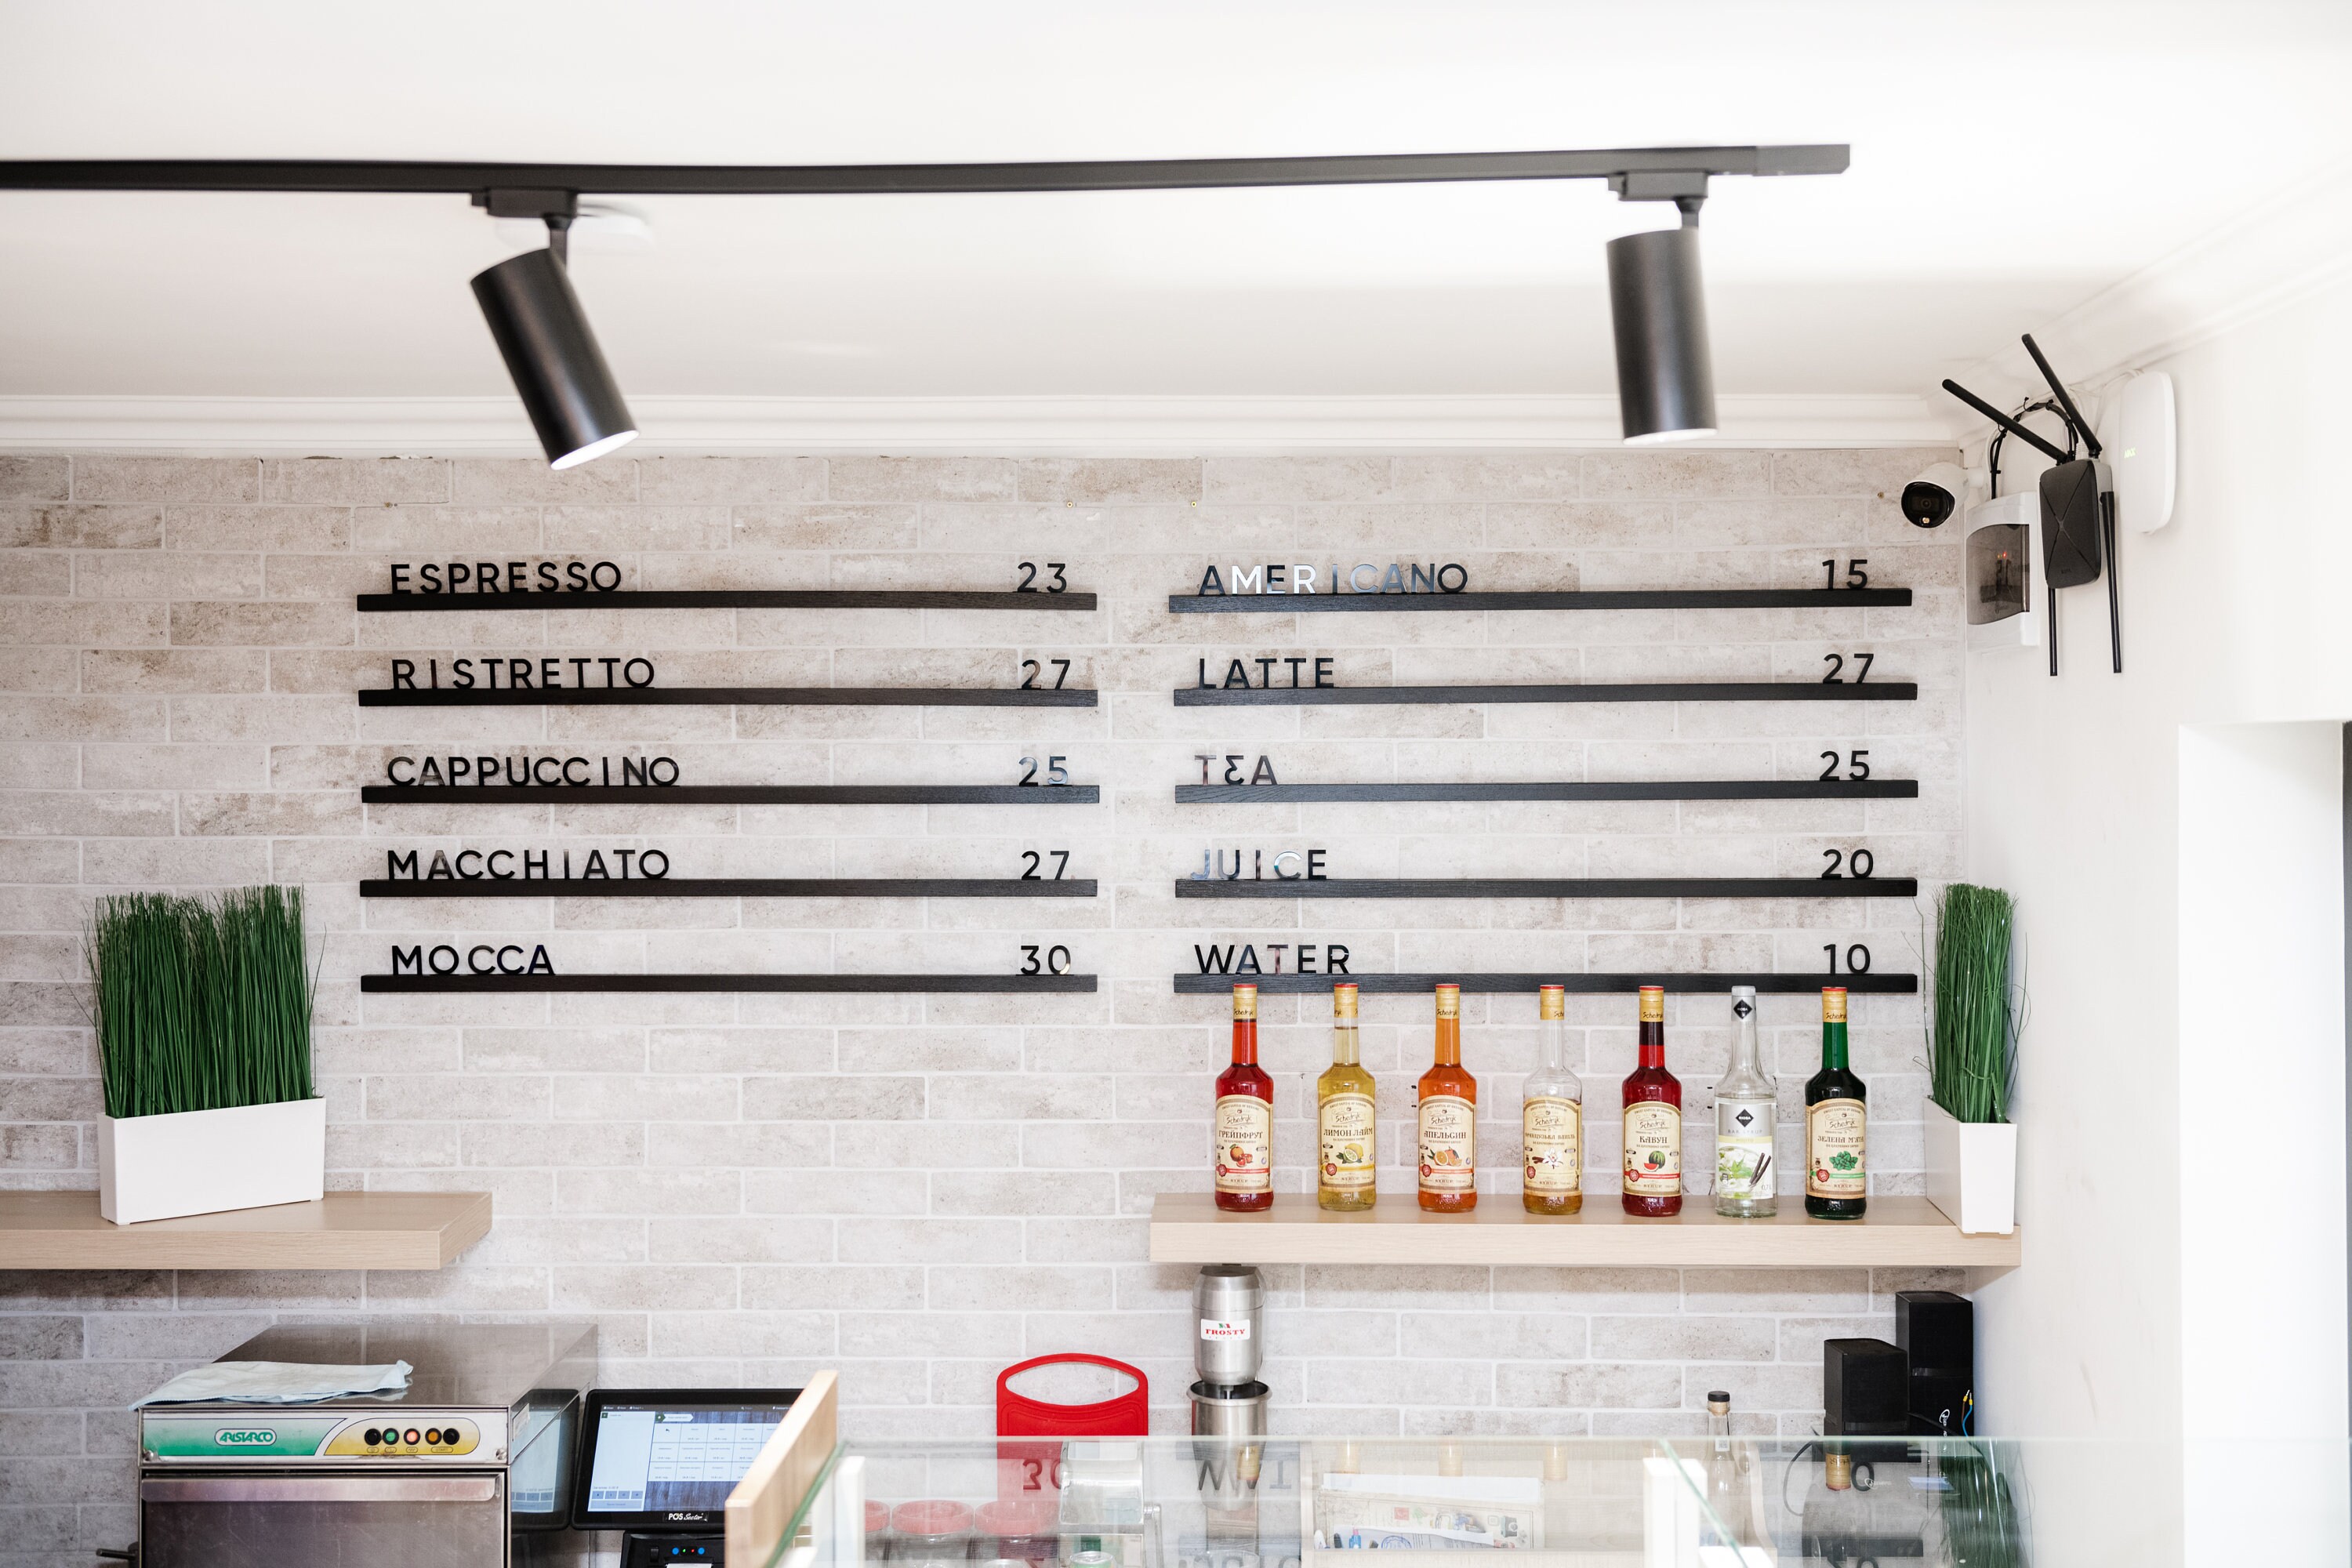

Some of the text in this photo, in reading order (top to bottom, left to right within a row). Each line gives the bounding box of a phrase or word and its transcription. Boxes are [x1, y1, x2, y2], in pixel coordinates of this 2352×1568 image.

[391, 561, 1067, 594] ESPRESSO 23
[1198, 559, 1868, 595] AMERICANO 15
[391, 658, 1071, 690] RISTRETTO 27
[1198, 653, 1875, 688] LATTE 27
[387, 756, 1069, 787] CAPPUCCINO 25
[1819, 750, 1871, 781] 25
[387, 849, 1070, 880] MACCHIATO 27
[1190, 848, 1874, 880] JUICE 20
[391, 944, 1072, 975] MOCCA 30
[1193, 944, 1871, 975] WATER 10
[1352, 1126, 1373, 1136] ЛАЙМ
[1424, 1131, 1466, 1139] АПЕЛЬСИН
[219, 1432, 274, 1443] ARISTARCO
[668, 1512, 702, 1521] POS Sector
